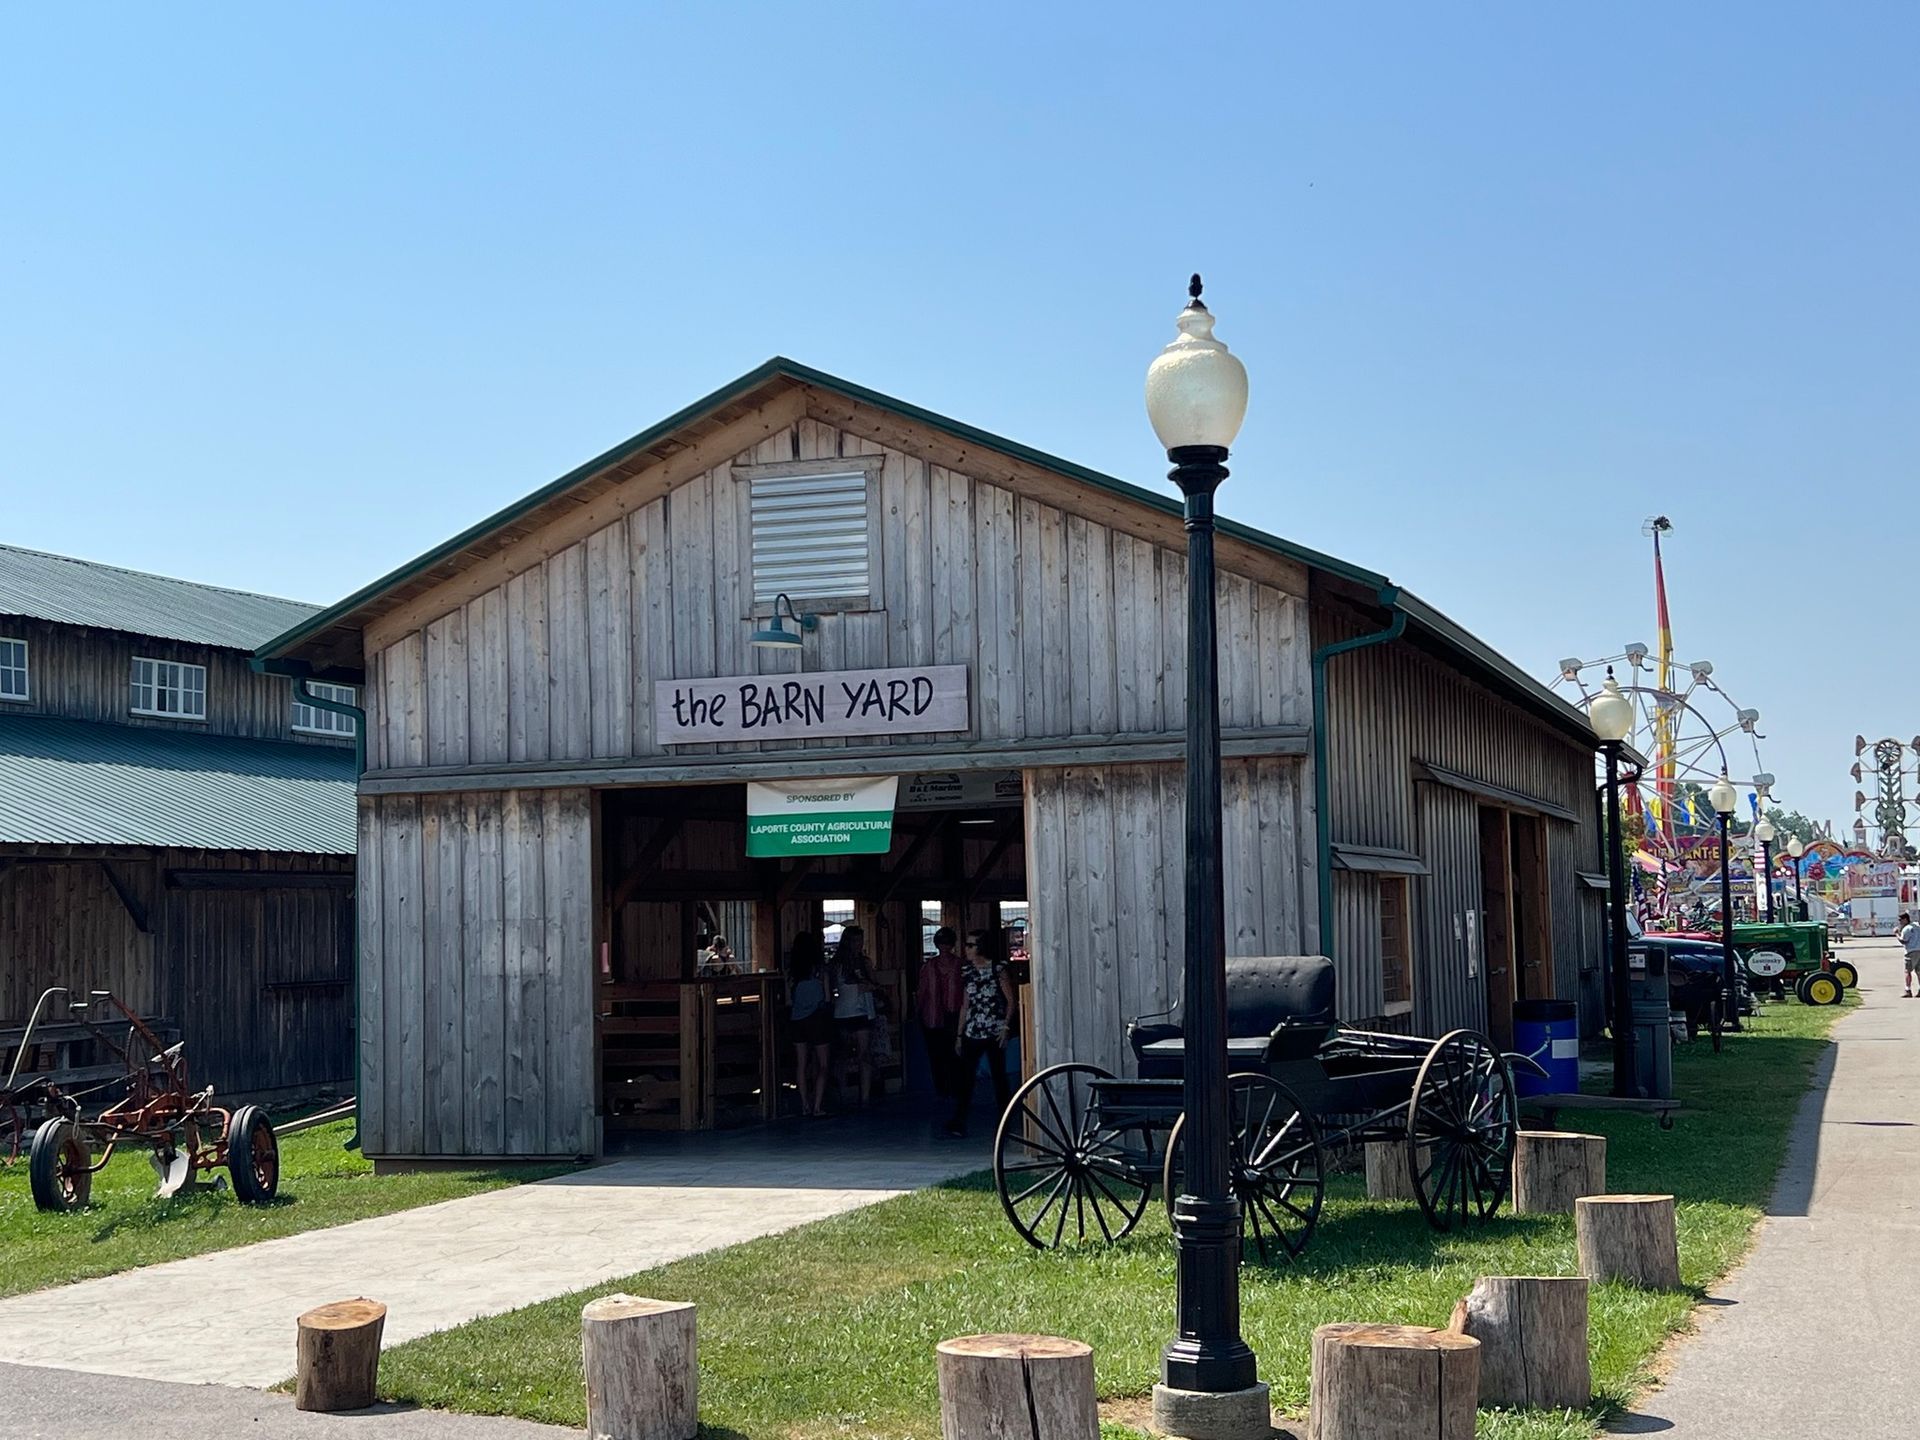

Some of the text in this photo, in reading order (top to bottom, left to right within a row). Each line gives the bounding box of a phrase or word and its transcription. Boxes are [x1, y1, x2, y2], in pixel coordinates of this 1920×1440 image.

[672, 677, 933, 728] the BARN YARD
[786, 792, 855, 803] SPONSORED BY
[750, 820, 892, 834] LAPORTE COUNTY AGRICULTURAL
[791, 833, 851, 844] ASSOCIATION
[1849, 870, 1896, 887] TICKETS
